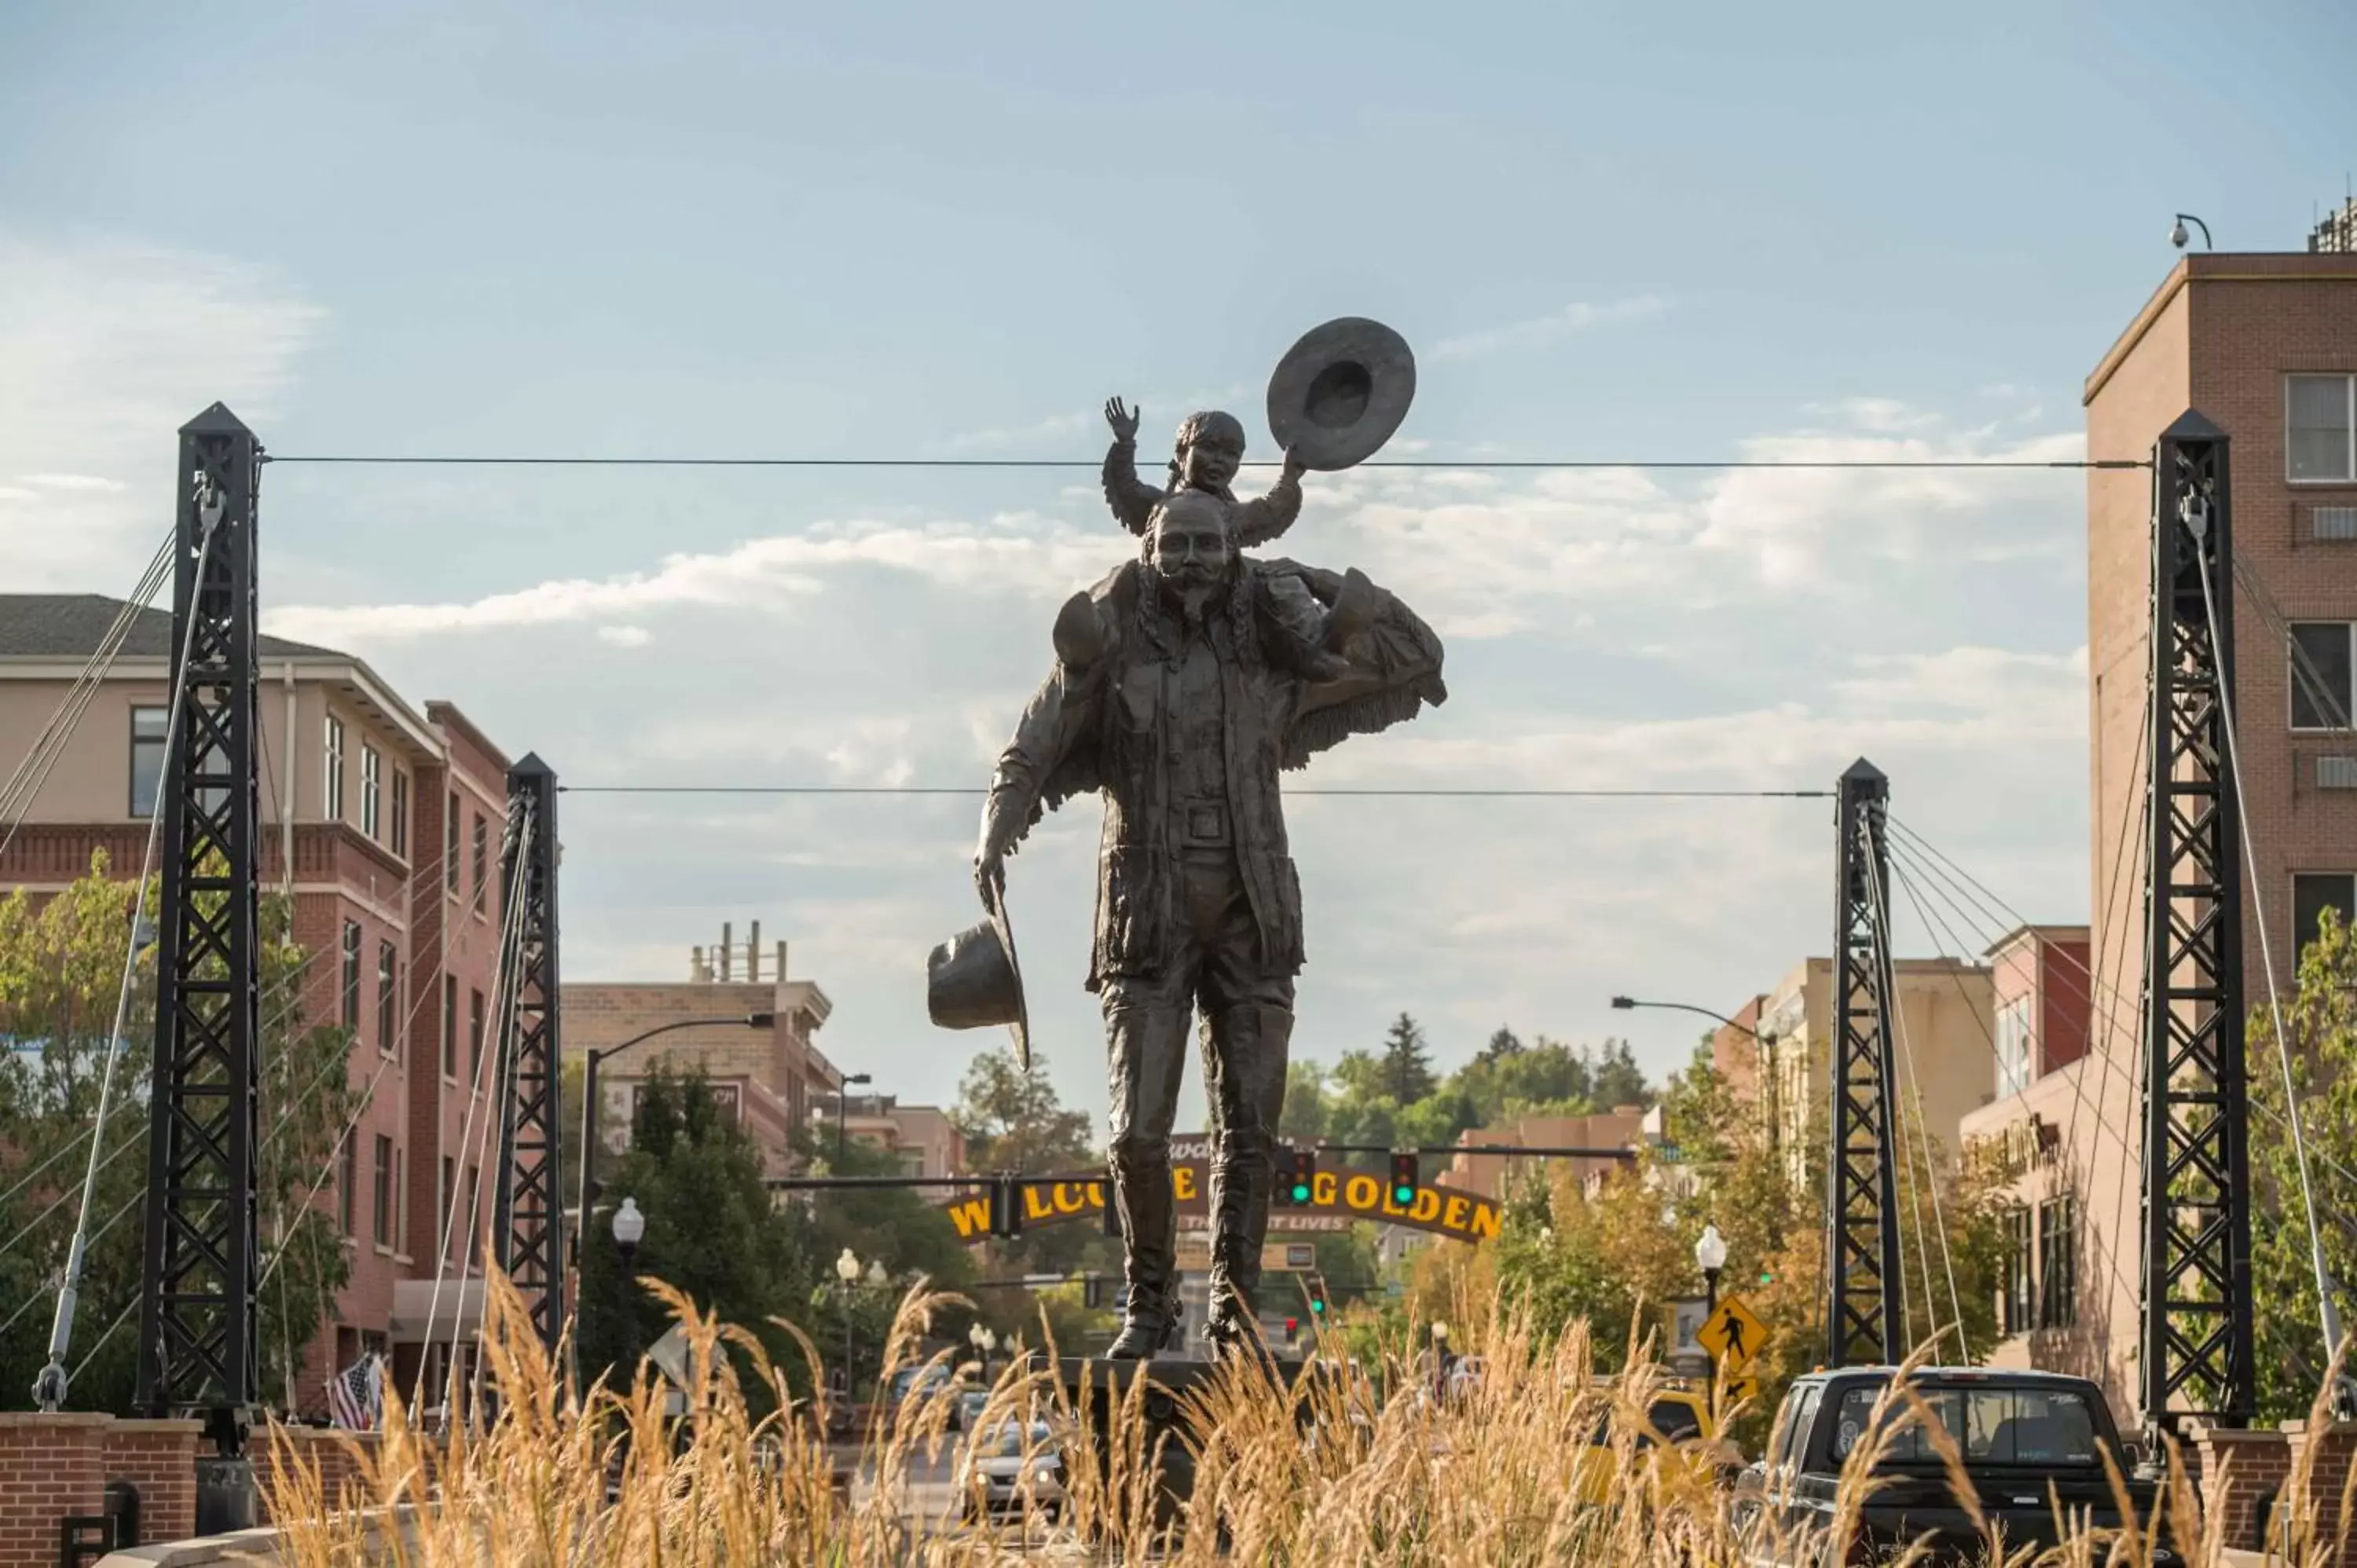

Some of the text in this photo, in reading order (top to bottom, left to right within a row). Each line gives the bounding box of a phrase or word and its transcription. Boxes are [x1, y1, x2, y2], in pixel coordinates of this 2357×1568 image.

[949, 1167, 1503, 1239] WLCE GOLDEN
[1289, 1216, 1344, 1231] LIVES
